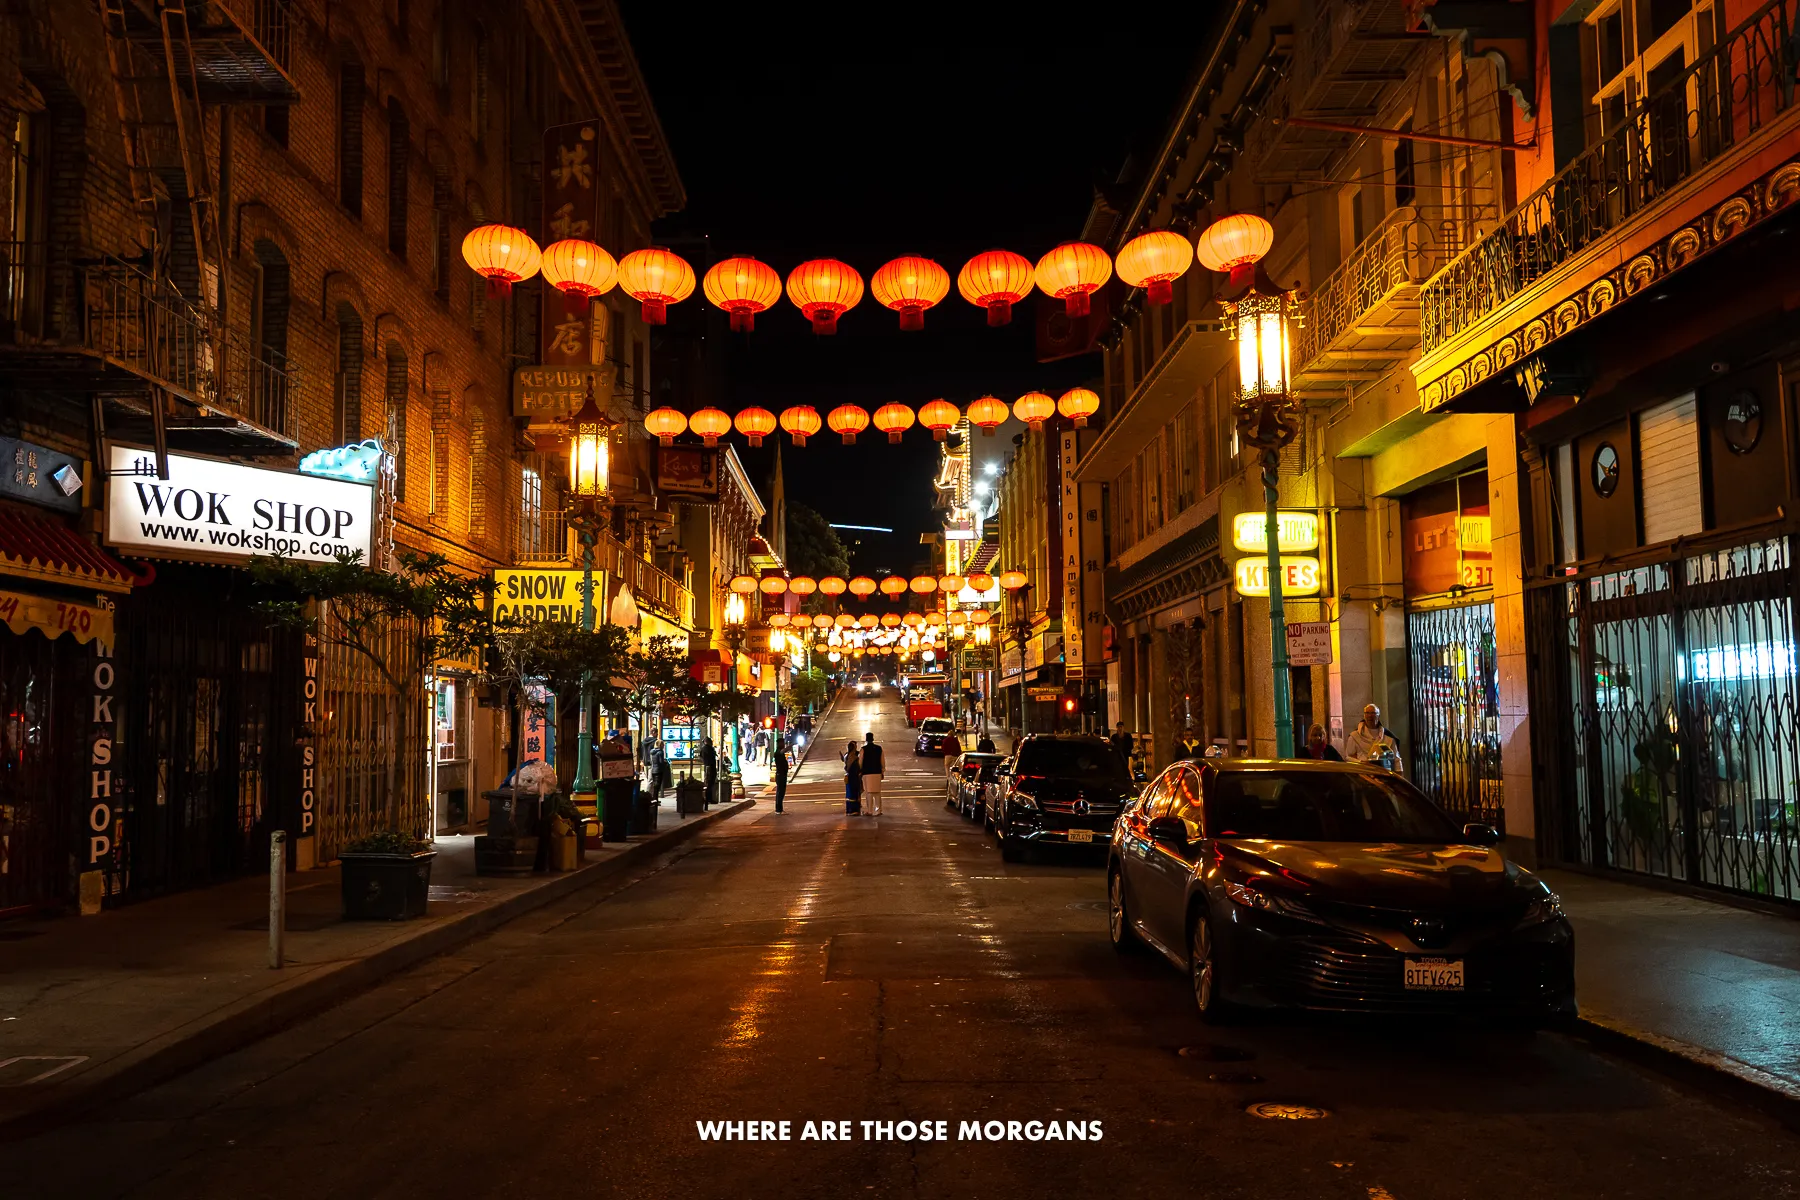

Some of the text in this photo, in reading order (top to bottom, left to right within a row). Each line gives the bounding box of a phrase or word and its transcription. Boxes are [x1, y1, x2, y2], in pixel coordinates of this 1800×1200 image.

[522, 391, 590, 409] HOTE
[133, 456, 160, 478] th
[1064, 439, 1073, 497] Bank
[133, 481, 354, 540] WOK SHOP
[1067, 511, 1074, 538] of
[140, 521, 350, 558] www.wokshop.com
[507, 575, 567, 600] SNOW
[1246, 564, 1314, 586] KIES
[57, 603, 91, 634] 720
[1067, 554, 1078, 657] America
[1288, 625, 1329, 636] NO PARKING
[303, 657, 318, 722] WOK
[90, 738, 113, 864] SHOP
[302, 746, 315, 833] SHOP
